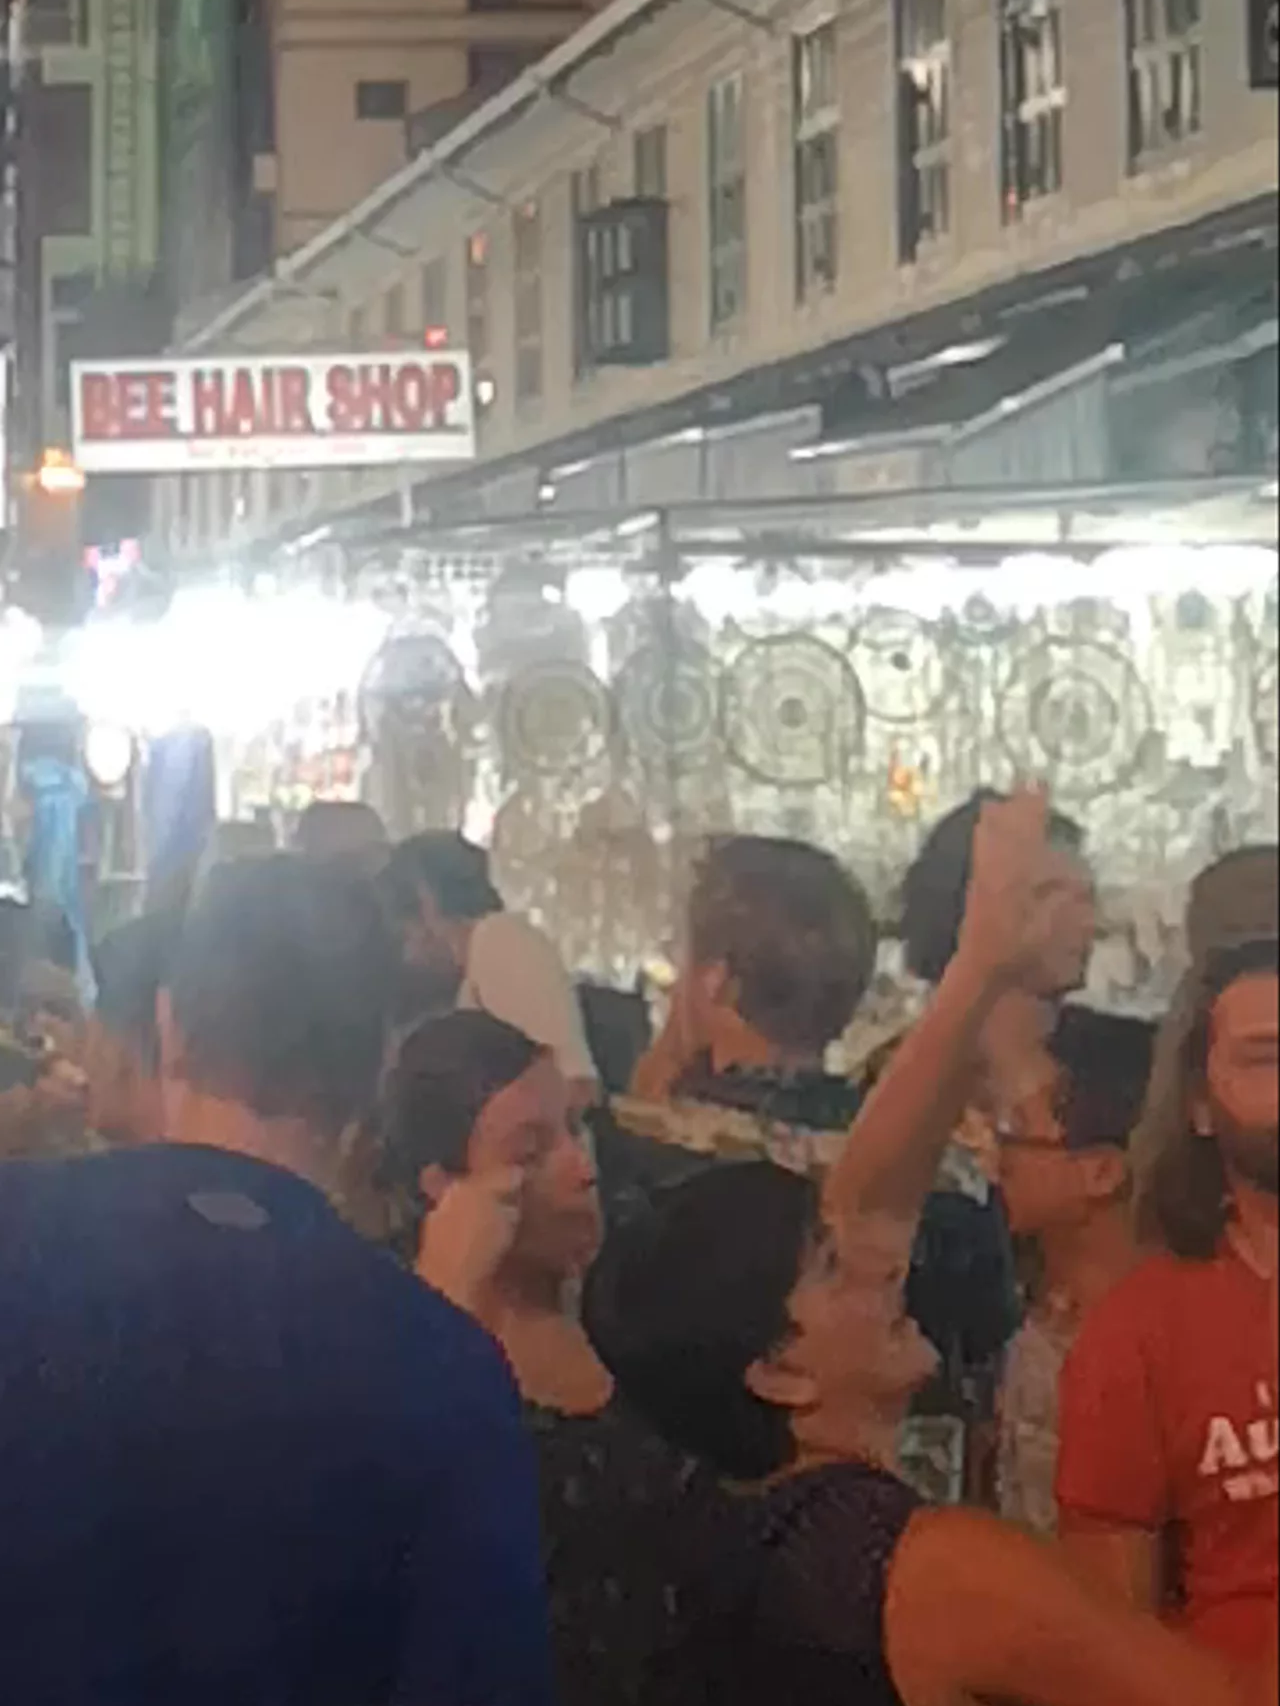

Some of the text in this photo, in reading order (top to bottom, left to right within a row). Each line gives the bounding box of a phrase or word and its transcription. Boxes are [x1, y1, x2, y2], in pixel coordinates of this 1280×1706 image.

[81, 362, 464, 440] BEE HAIR SHOP
